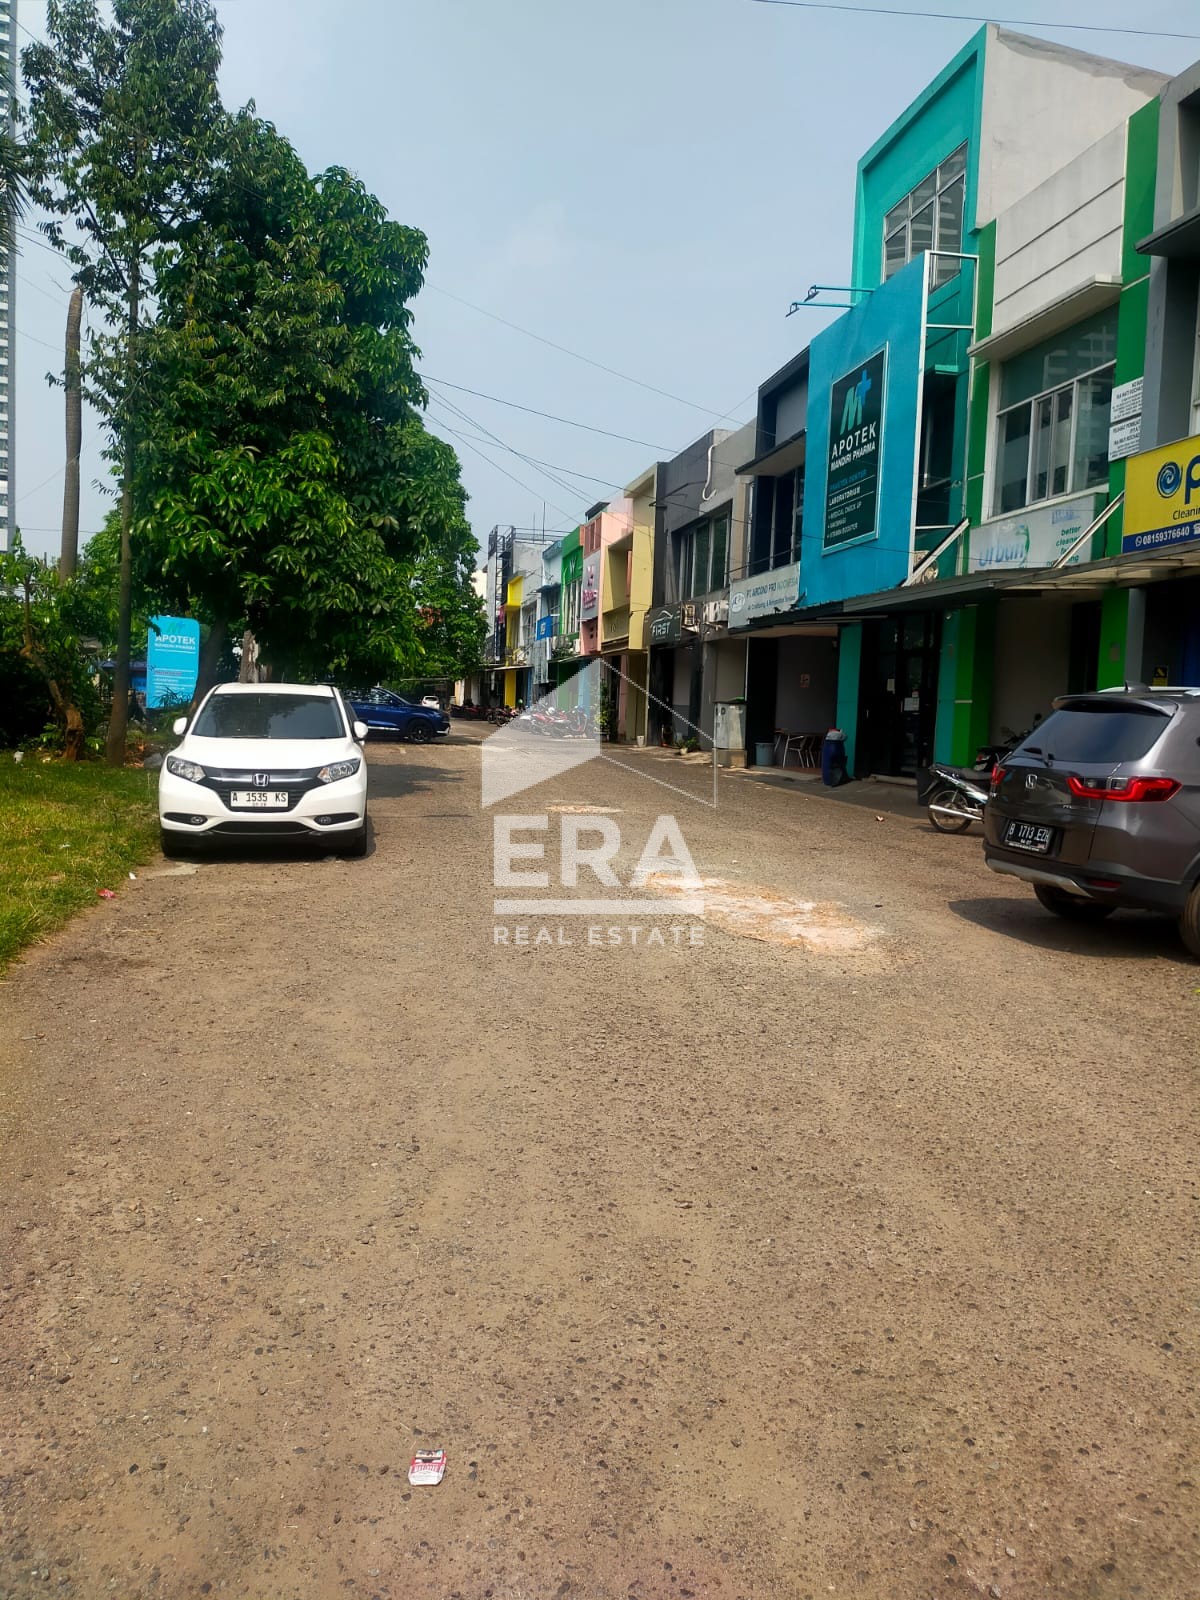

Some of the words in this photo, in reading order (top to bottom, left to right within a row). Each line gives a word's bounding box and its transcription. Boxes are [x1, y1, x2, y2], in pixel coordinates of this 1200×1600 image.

[831, 421, 876, 460] APOTEK
[830, 453, 852, 471] MANDIRI
[853, 441, 876, 460] PHARMA
[155, 634, 196, 645] APOTEK
[232, 792, 238, 802] A
[246, 792, 268, 802] 1535
[275, 792, 287, 803] KS
[1018, 825, 1035, 839] 1713
